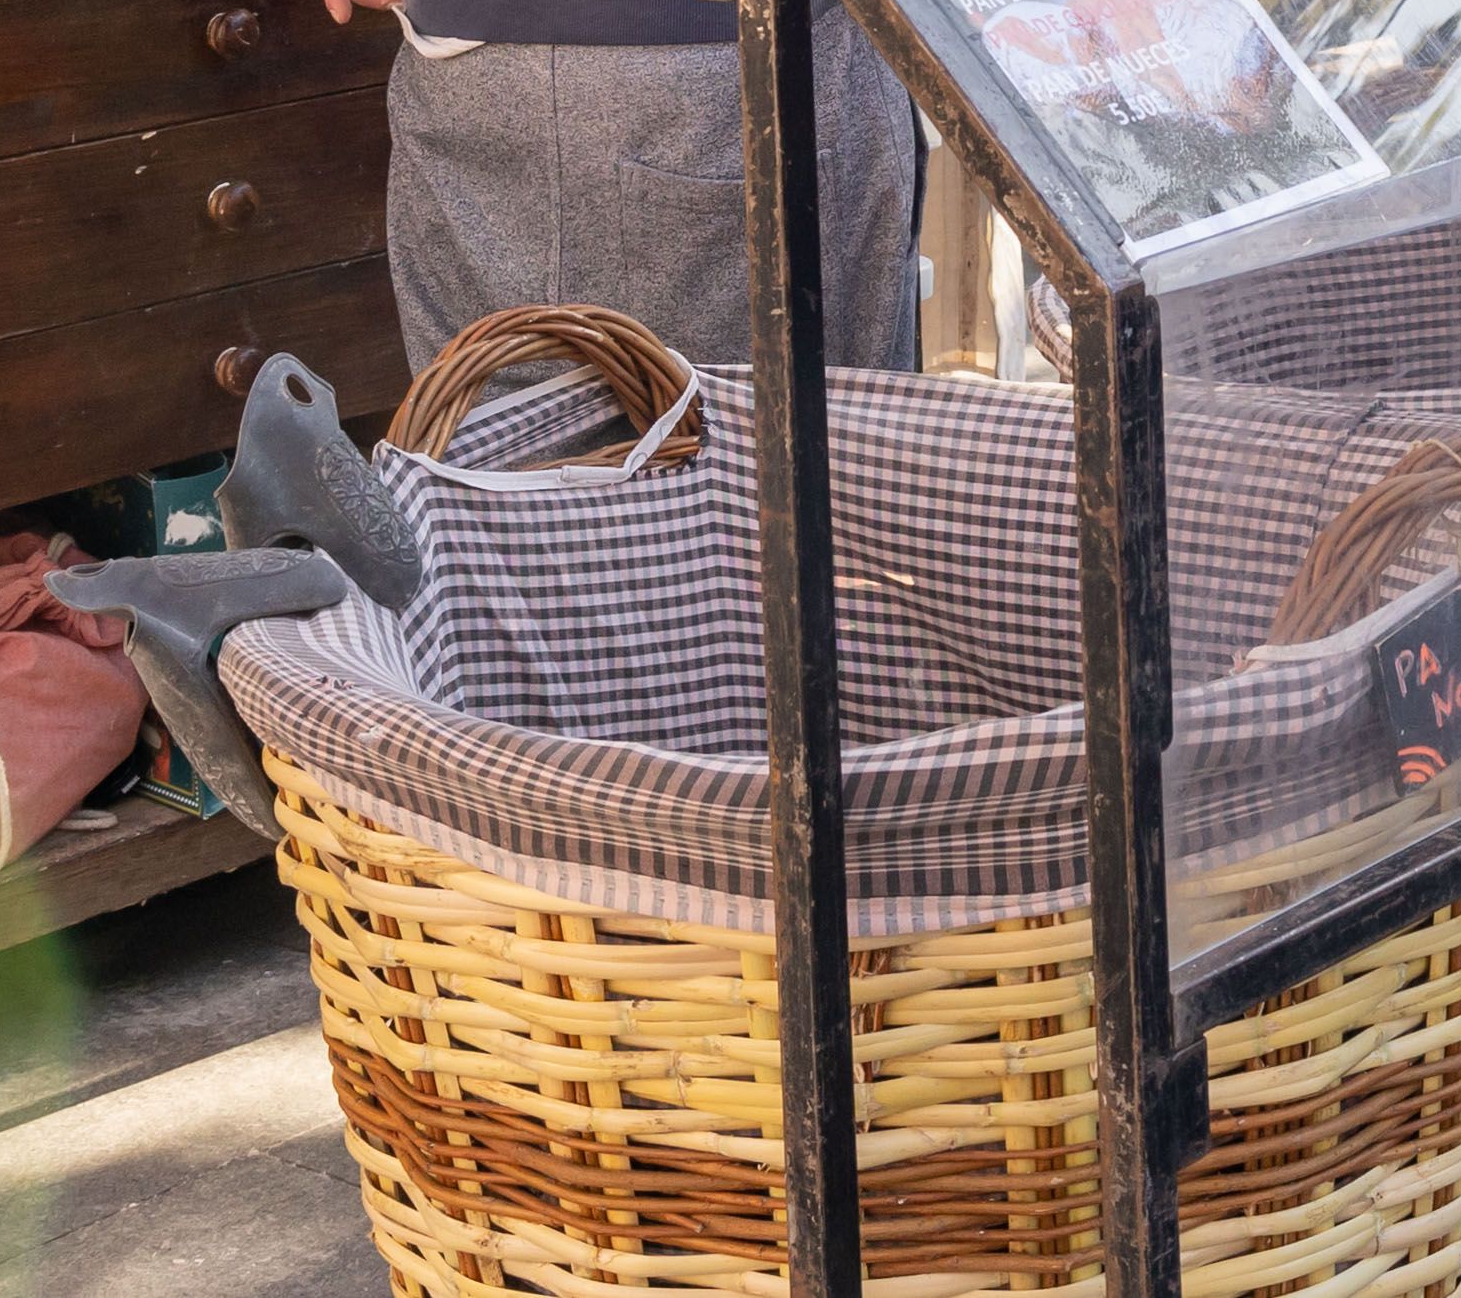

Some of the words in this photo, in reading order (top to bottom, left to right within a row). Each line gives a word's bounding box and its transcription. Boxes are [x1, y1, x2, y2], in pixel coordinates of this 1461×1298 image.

[1025, 72, 1078, 101] PAN
[1075, 62, 1109, 86] DE
[1395, 643, 1441, 697] PA
